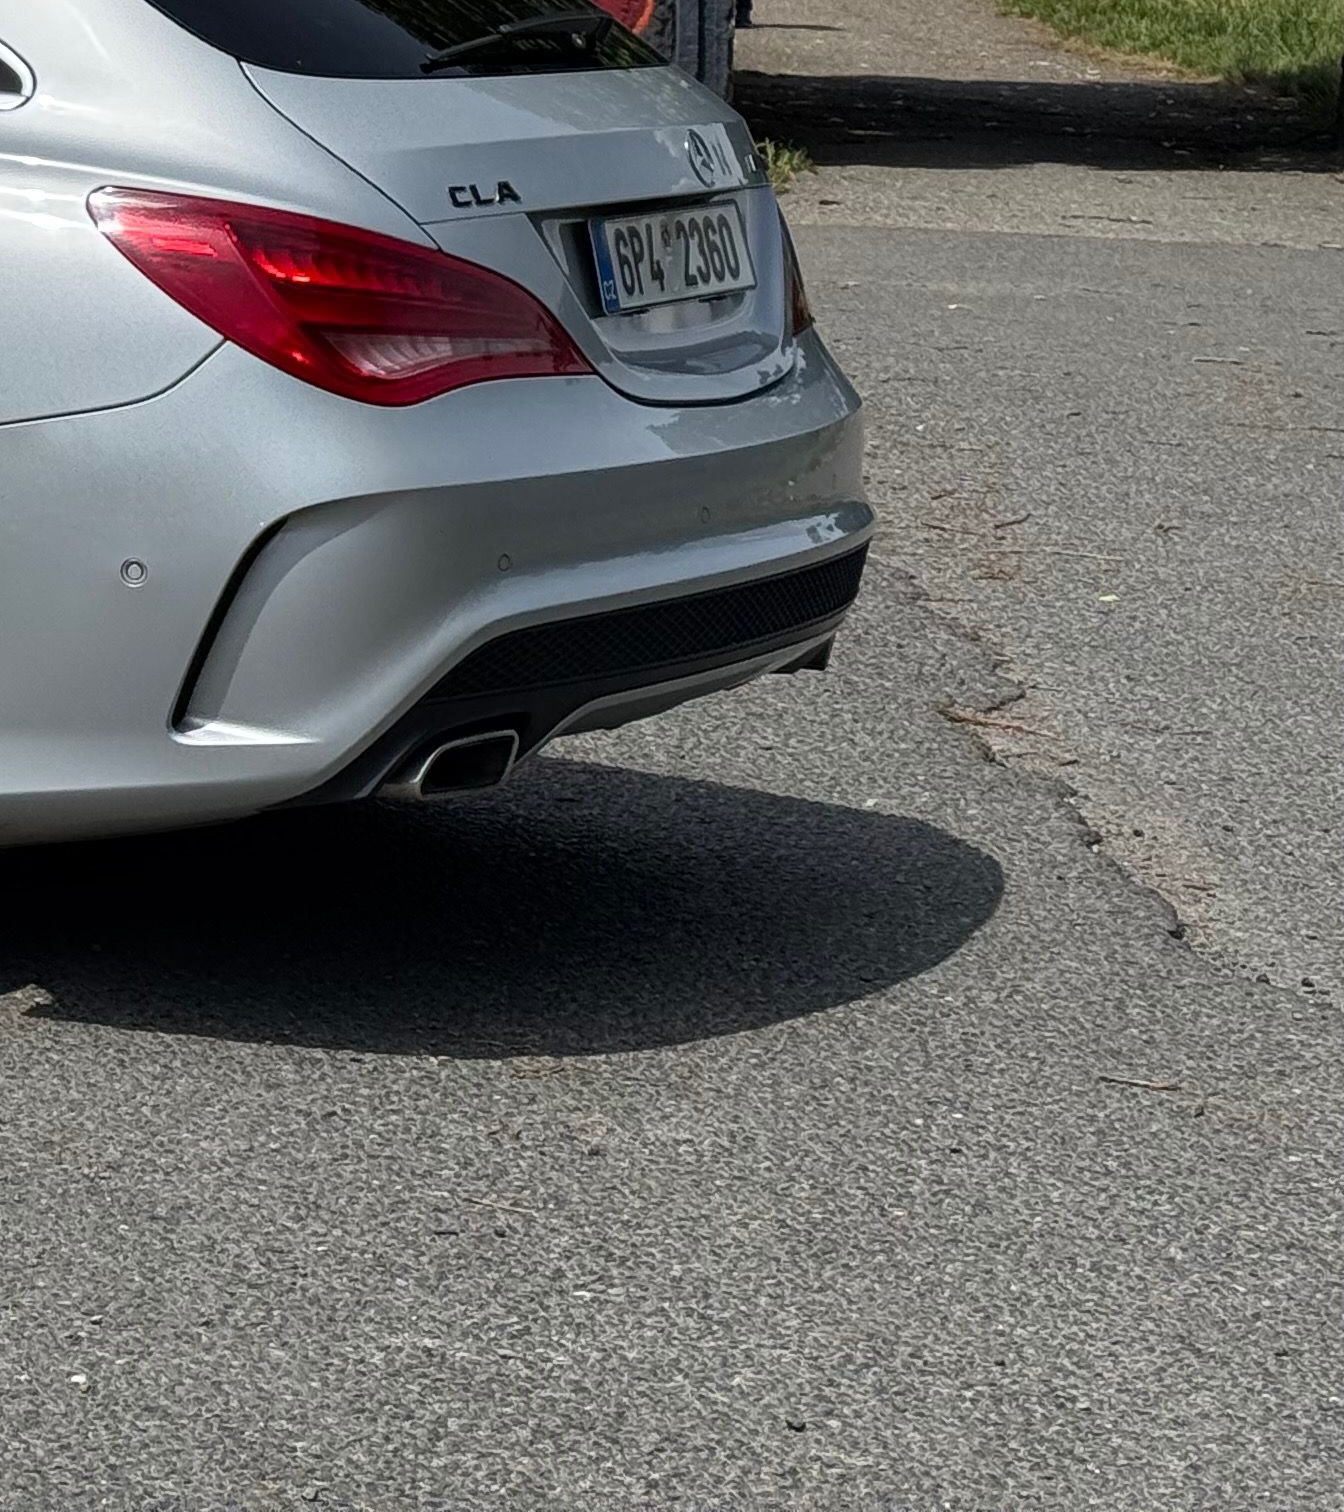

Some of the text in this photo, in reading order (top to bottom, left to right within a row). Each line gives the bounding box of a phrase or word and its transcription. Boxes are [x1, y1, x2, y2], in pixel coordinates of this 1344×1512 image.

[448, 181, 523, 208] CLA
[614, 213, 741, 297] 6P4 2360
